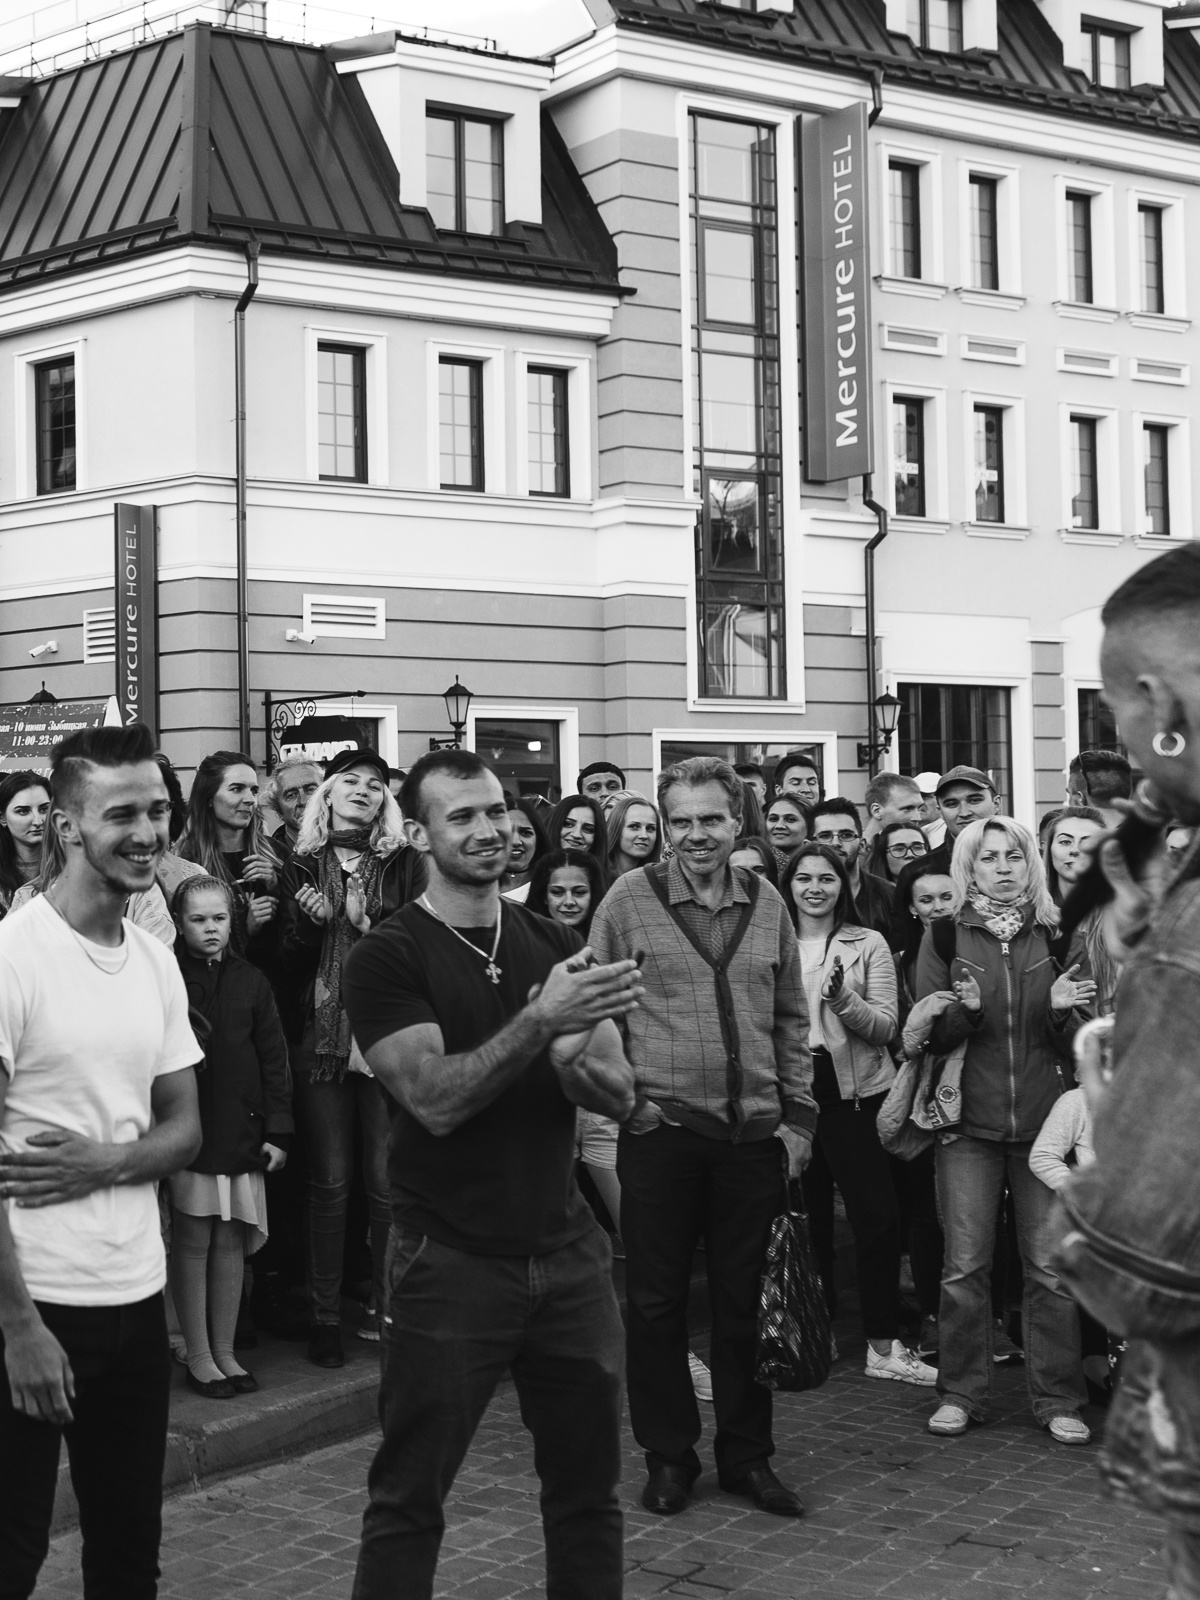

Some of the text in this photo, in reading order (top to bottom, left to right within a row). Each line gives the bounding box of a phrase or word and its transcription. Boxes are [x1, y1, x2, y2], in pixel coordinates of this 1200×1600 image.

[832, 134, 859, 447] Mercure HOTEL
[125, 523, 138, 727] Mercure HOTEL
[11, 734, 64, 747] 11:00-23:00
